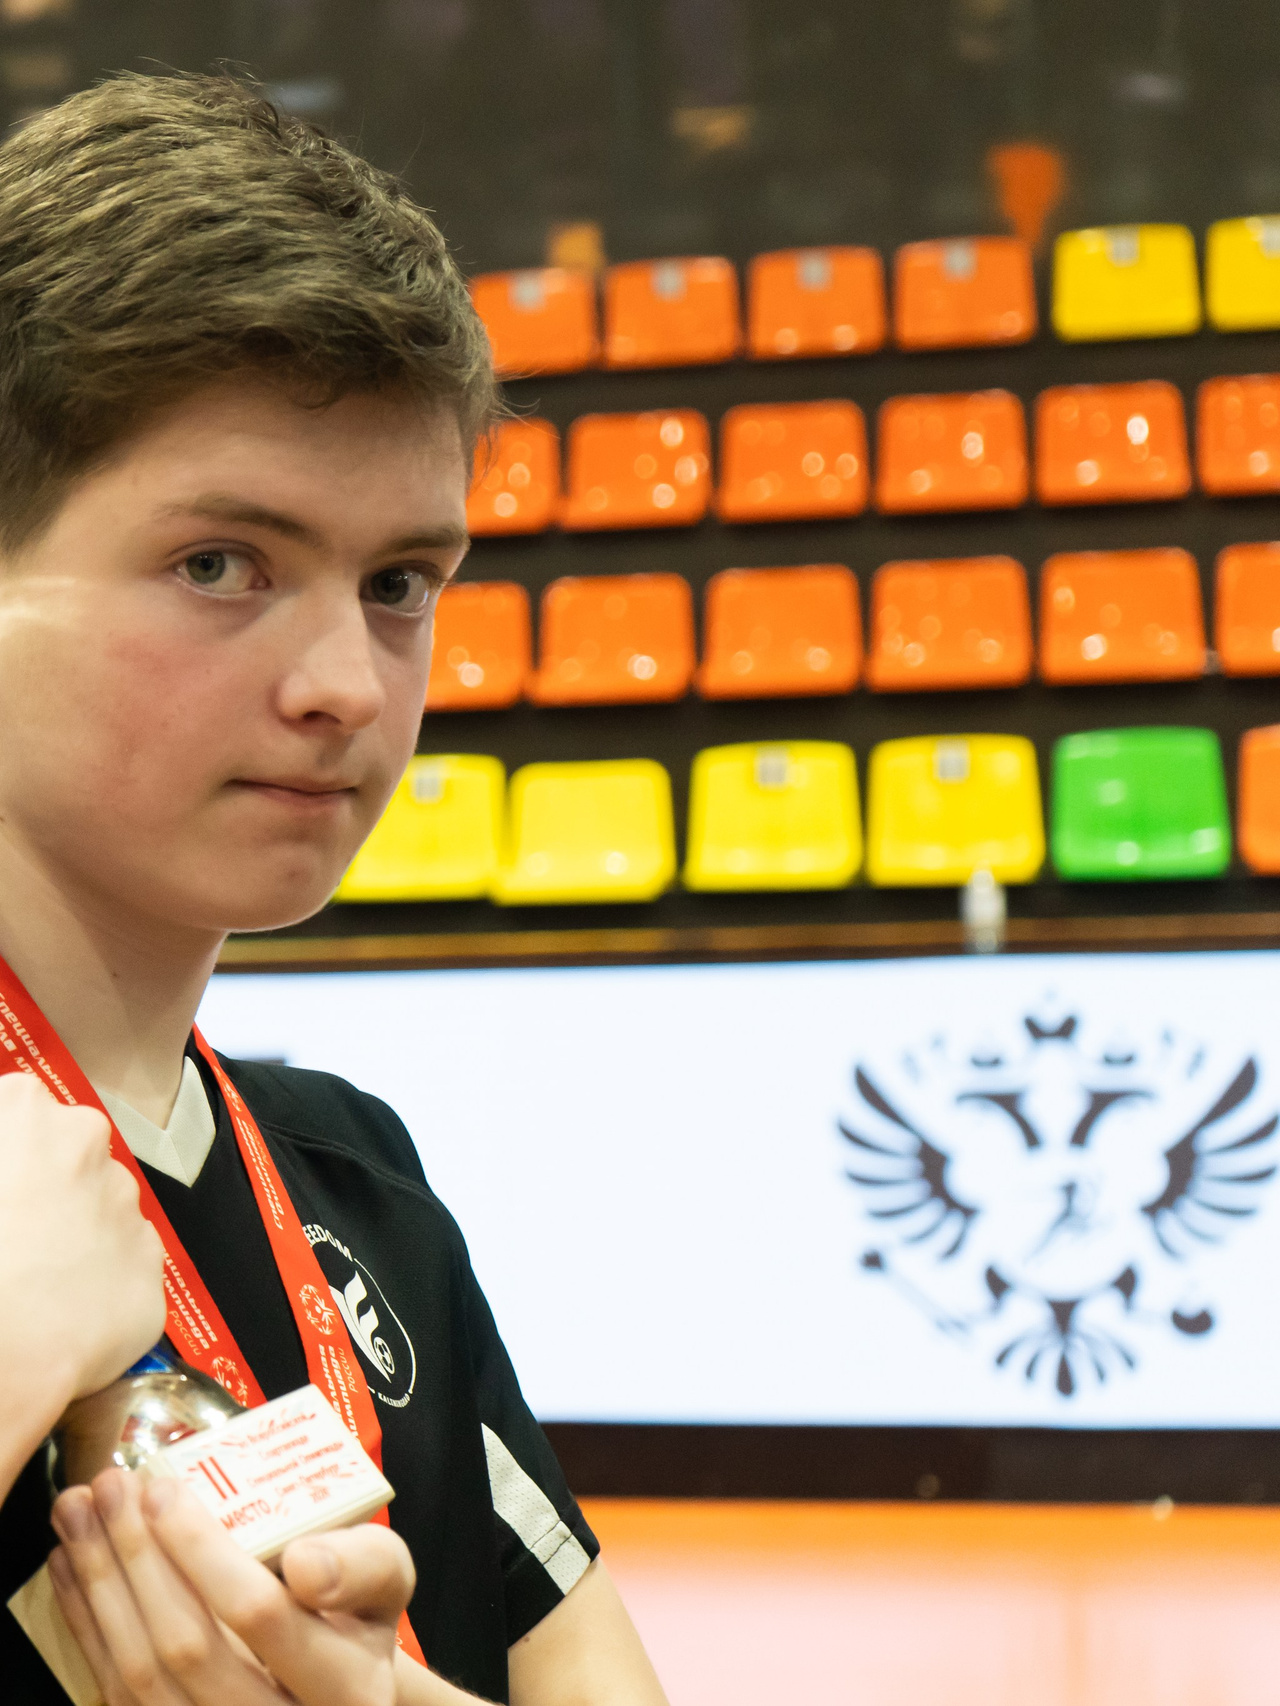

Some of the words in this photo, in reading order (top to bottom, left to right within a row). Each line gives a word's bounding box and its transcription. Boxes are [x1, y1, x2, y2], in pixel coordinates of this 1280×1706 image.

[301, 1223, 355, 1263] EEDOM
[168, 1309, 202, 1358] России
[327, 1345, 360, 1440] лимпиада
[337, 1347, 359, 1394] России
